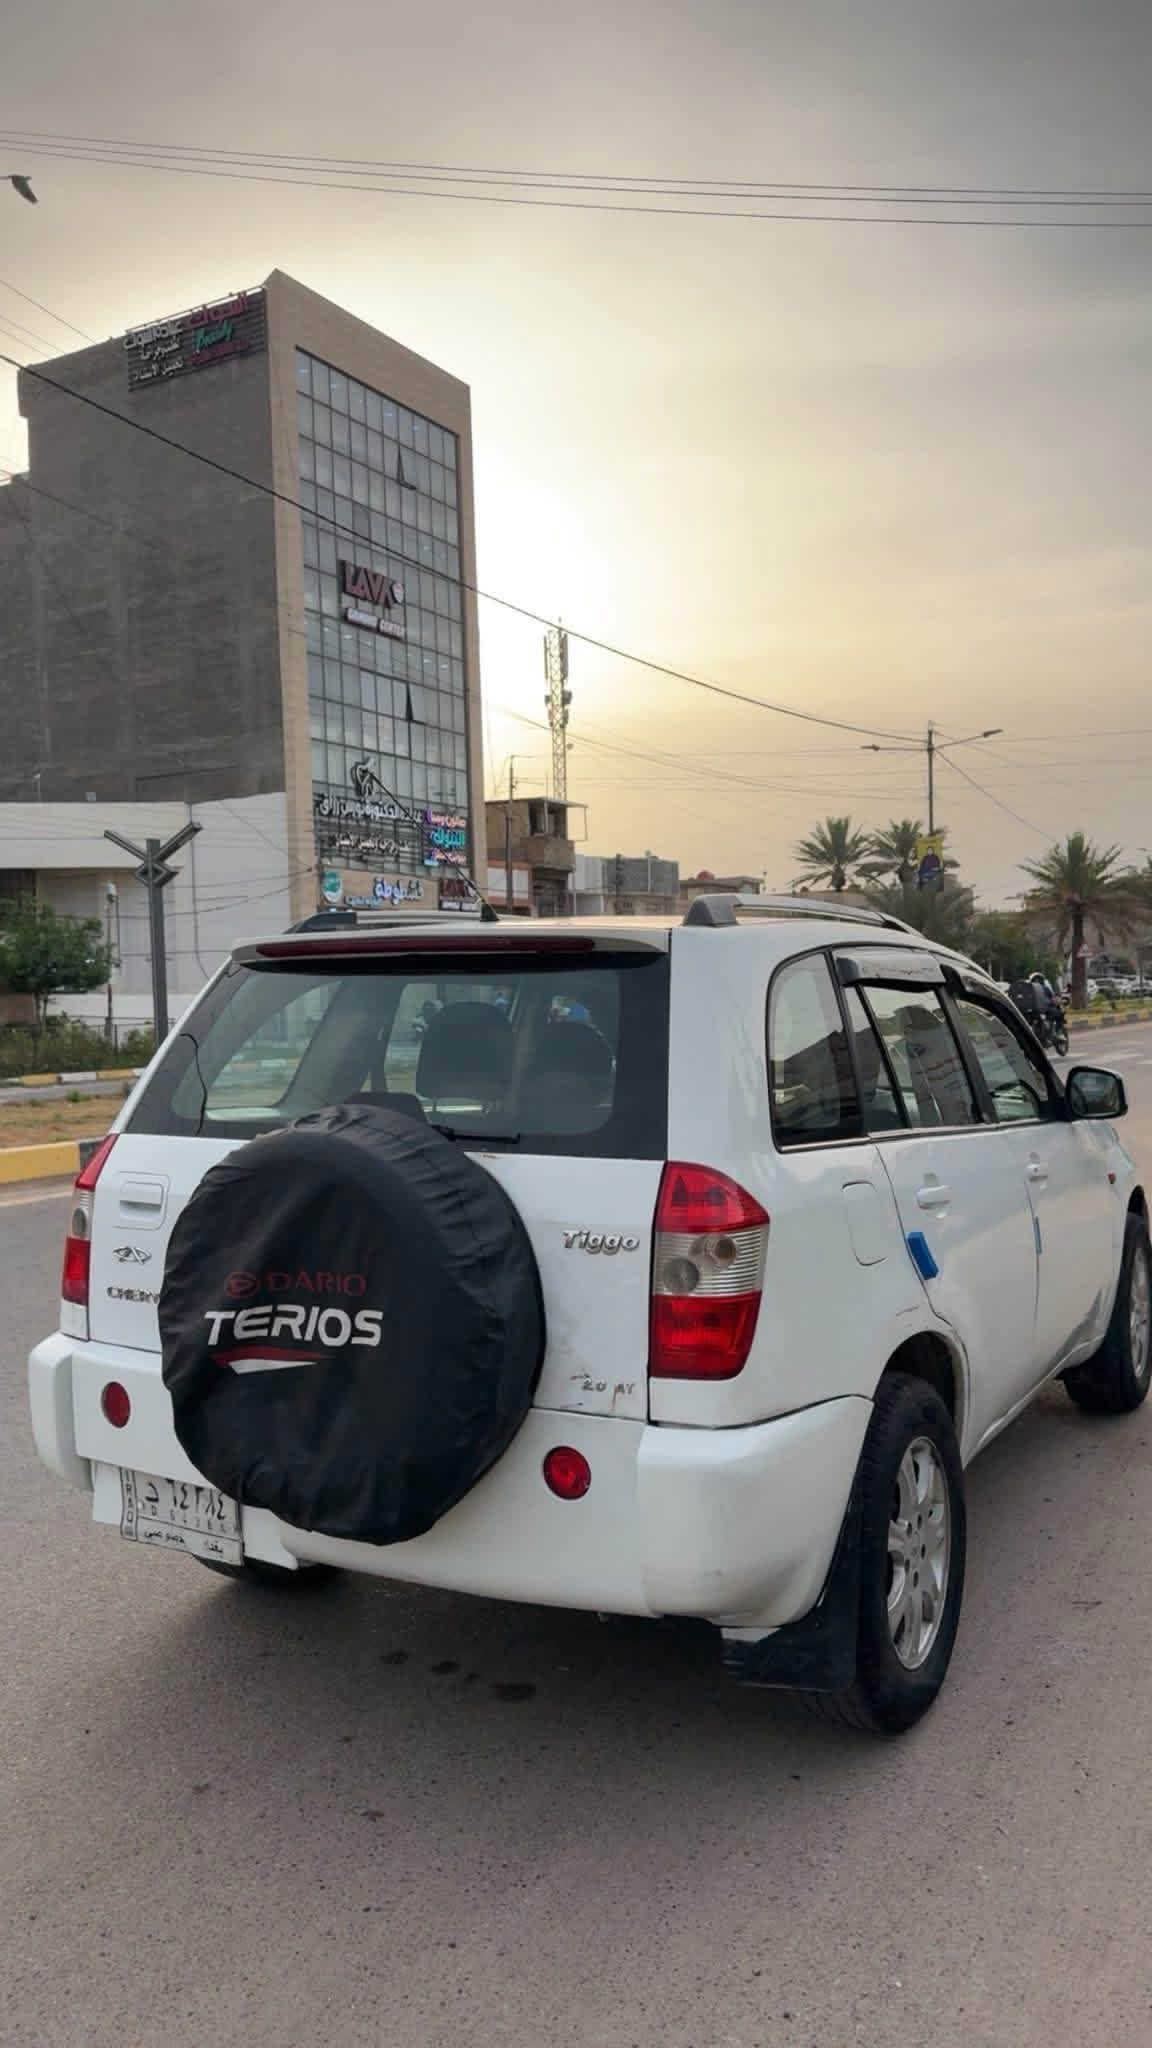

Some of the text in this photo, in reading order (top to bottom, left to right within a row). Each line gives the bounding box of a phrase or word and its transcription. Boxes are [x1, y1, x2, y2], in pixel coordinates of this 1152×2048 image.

[563, 1230, 640, 1256] Tiggo
[266, 1271, 368, 1297] DARIO
[204, 1304, 384, 1348] TERIOS
